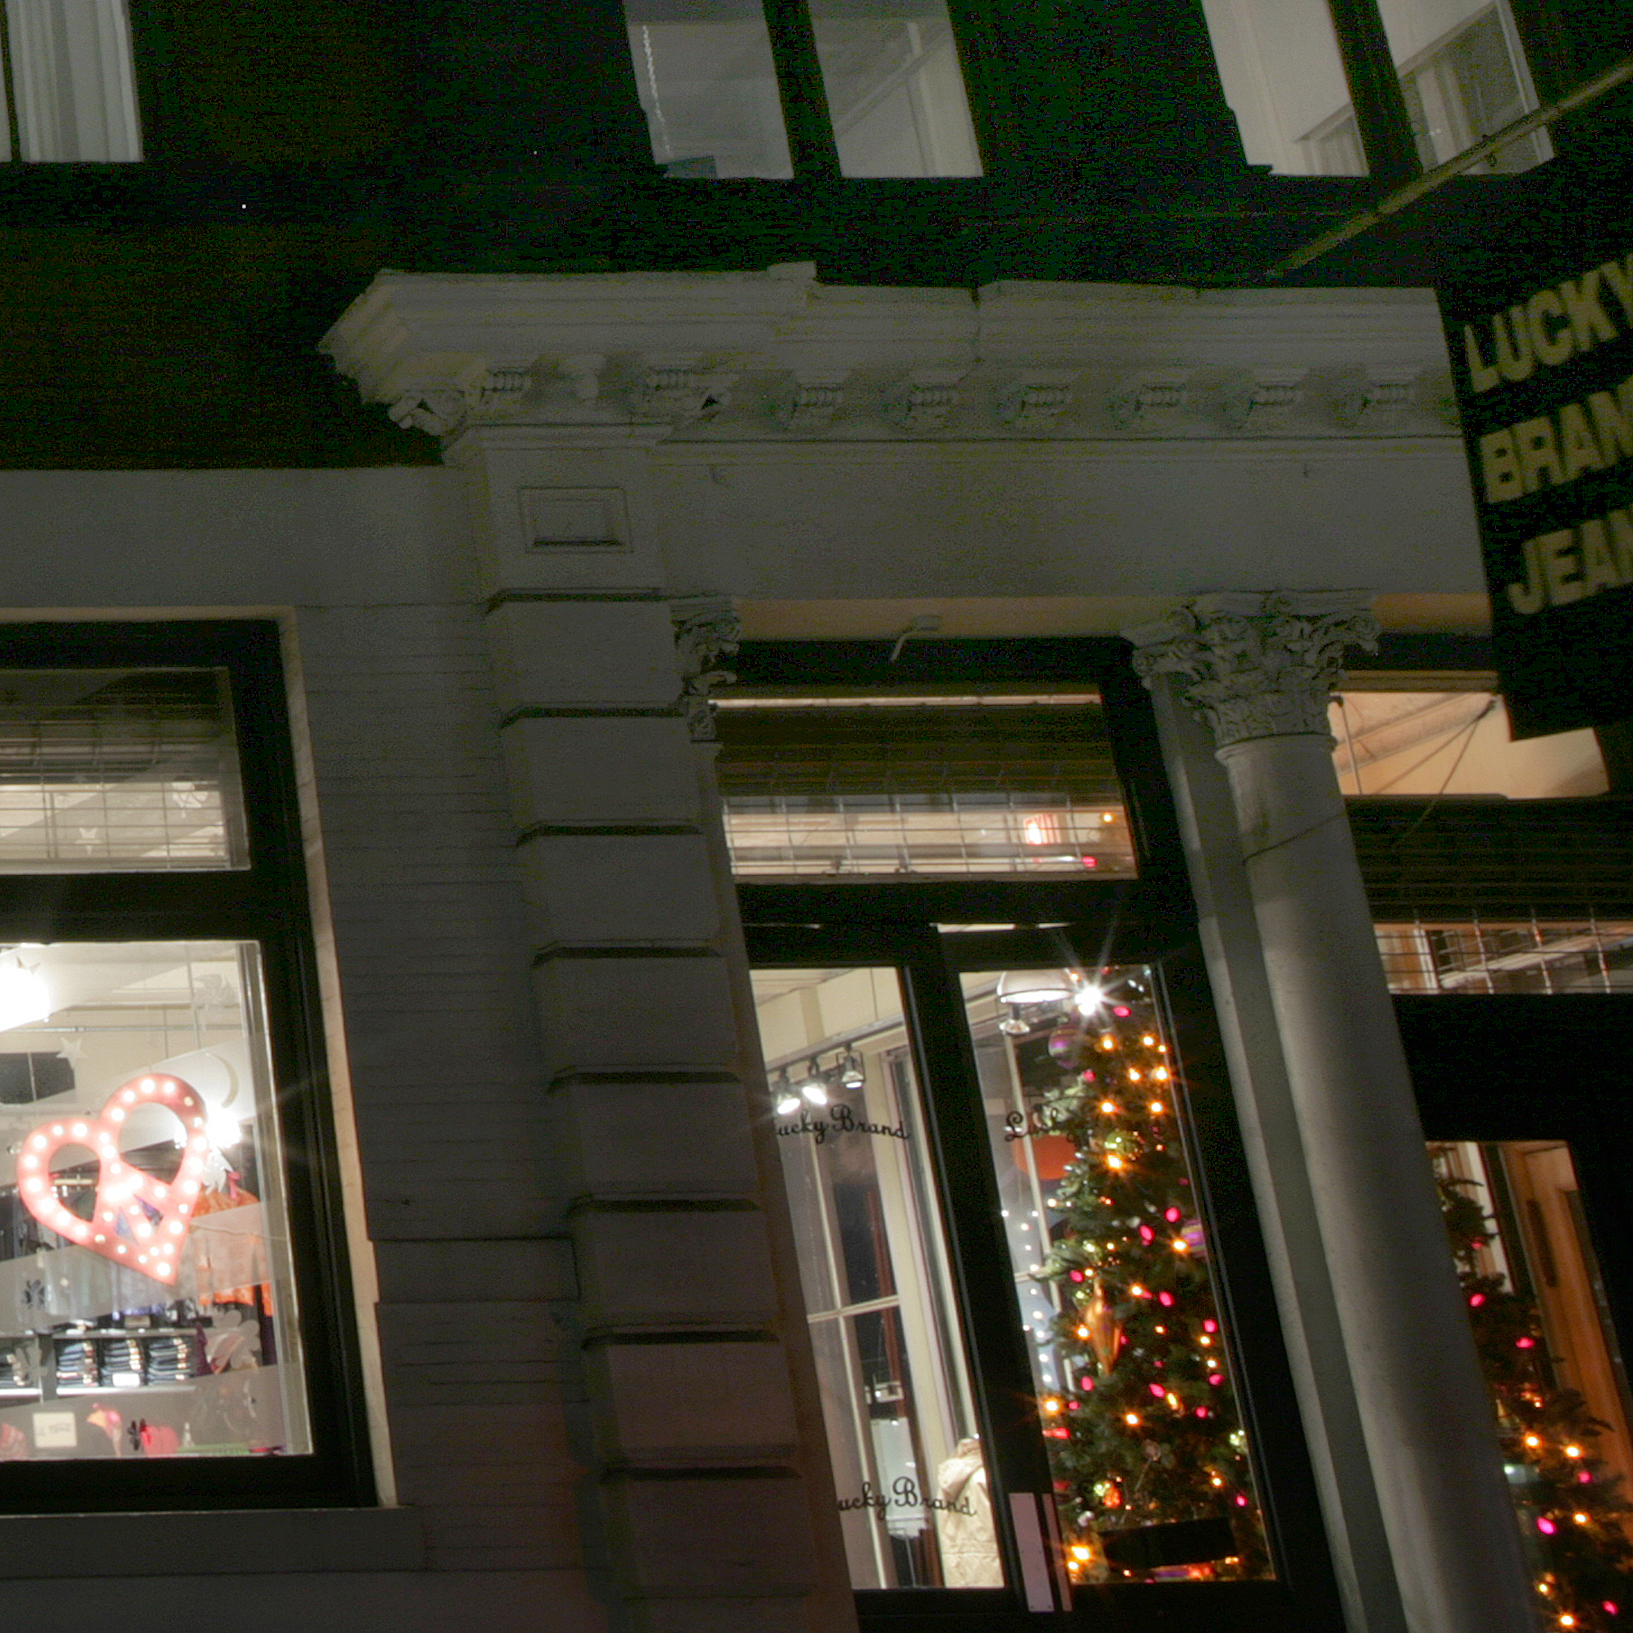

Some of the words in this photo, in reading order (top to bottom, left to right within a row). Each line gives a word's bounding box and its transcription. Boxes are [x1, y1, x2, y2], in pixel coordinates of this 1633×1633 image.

[775, 1109, 827, 1144] ucky
[830, 1103, 910, 1140] Brand
[836, 1481, 891, 1521] ucky
[893, 1476, 977, 1517] Brand
